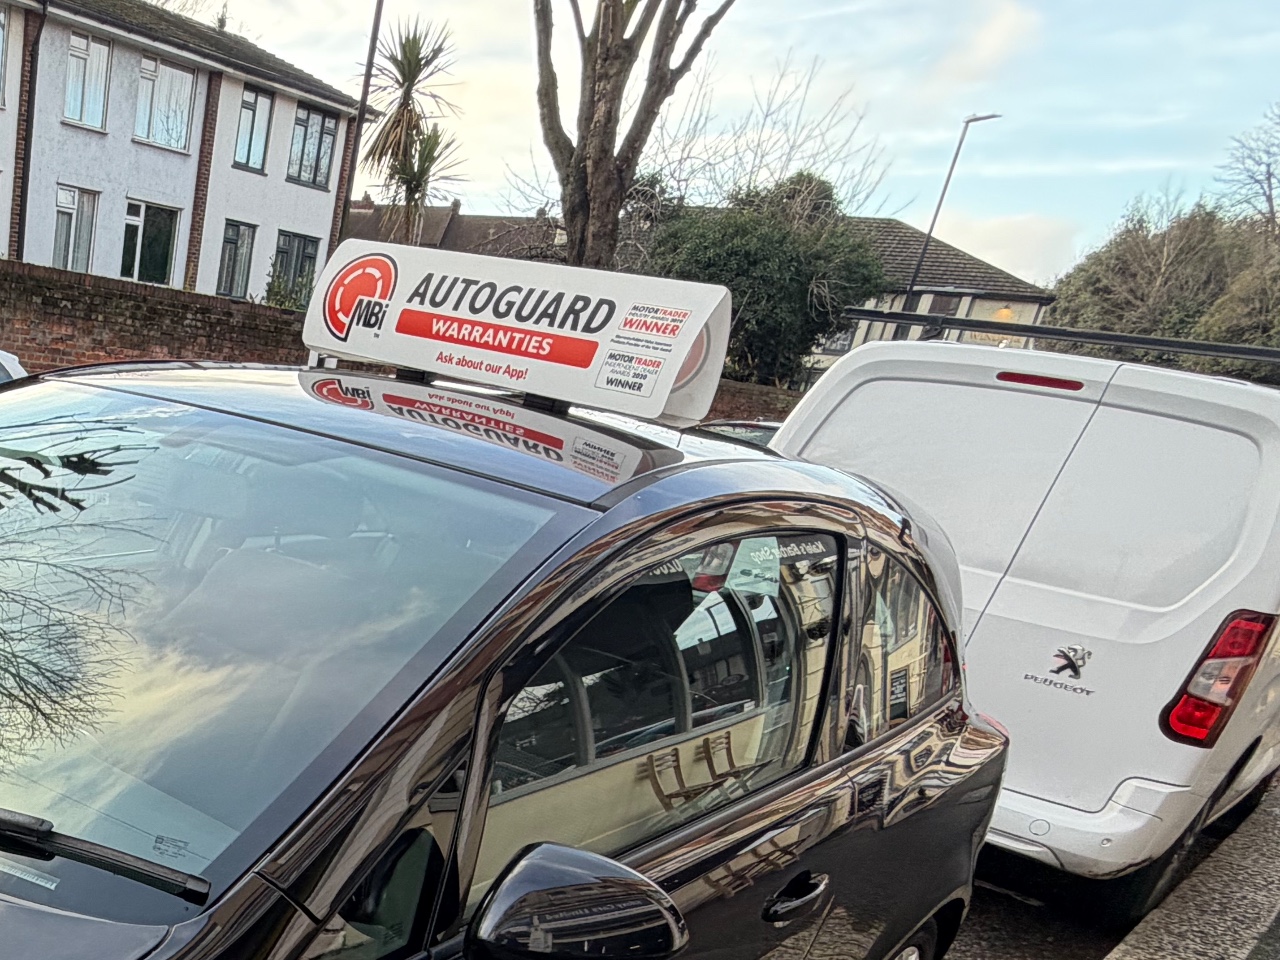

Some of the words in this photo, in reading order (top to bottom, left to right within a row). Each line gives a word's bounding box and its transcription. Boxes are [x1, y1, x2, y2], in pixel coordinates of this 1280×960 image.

[406, 272, 617, 334] AUTOGUARD
[431, 318, 553, 356] WARRANTIES
[623, 317, 680, 337] WINNER
[435, 351, 454, 365] Ask
[455, 355, 483, 371] about
[484, 363, 502, 374] our
[502, 364, 529, 380] App!
[606, 375, 644, 392] WINNER
[1023, 673, 1095, 696] PEUGEOT
